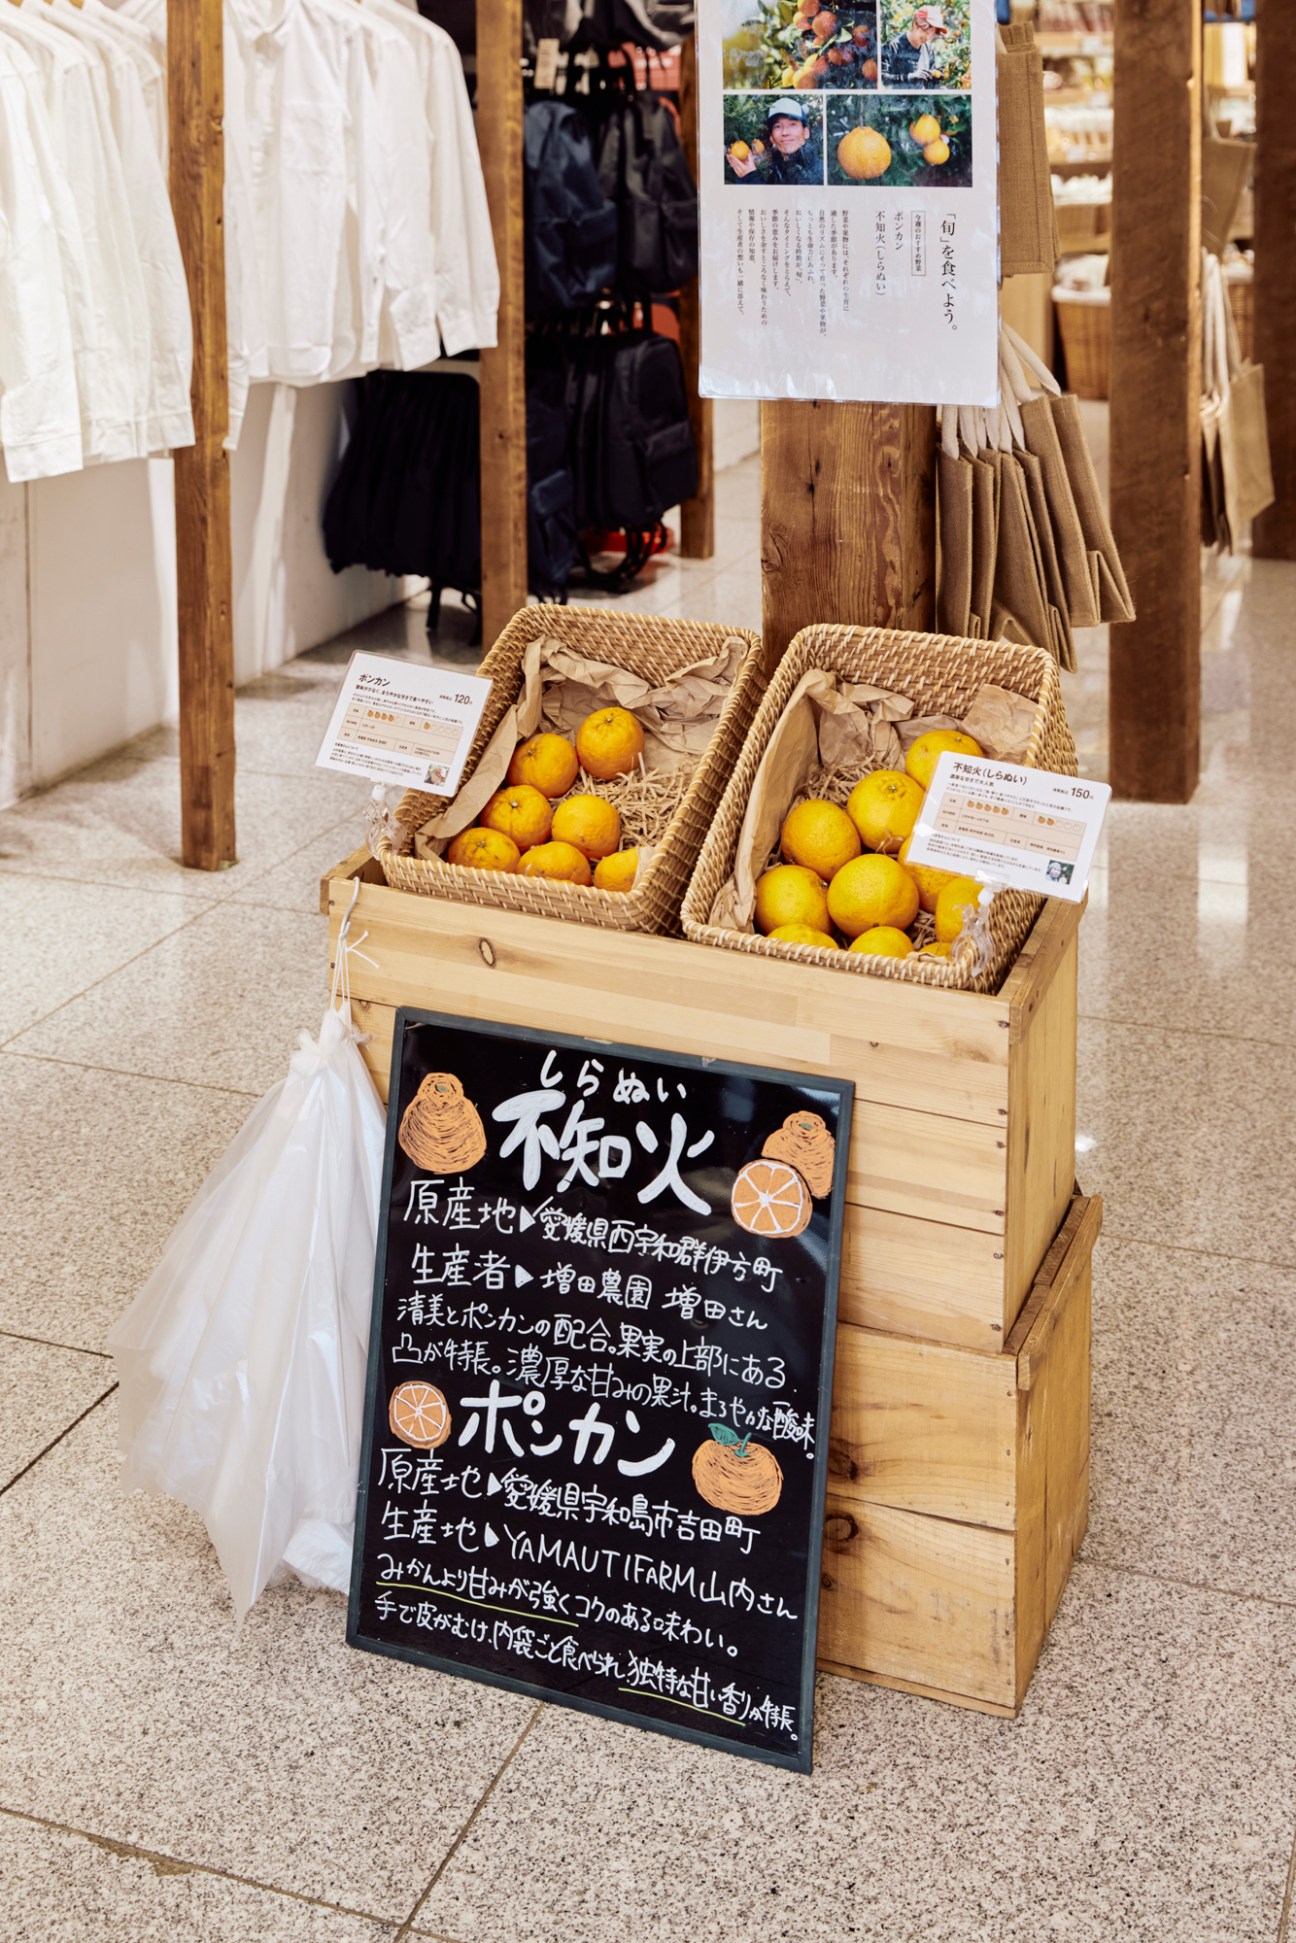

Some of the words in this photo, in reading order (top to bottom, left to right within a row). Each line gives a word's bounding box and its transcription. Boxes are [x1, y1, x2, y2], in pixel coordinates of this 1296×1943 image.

[939, 212, 958, 331] 「旬」を食べよう。
[358, 673, 391, 687] ポンカン
[540, 1050, 687, 1103] しらぬい
[492, 1089, 714, 1216] 不知火
[403, 1176, 516, 1235] 原産地
[411, 1242, 511, 1290] 生産者
[539, 1261, 653, 1310] 増田農園
[661, 1282, 768, 1331] 増田さん
[458, 1379, 676, 1477] ポンカン
[377, 1448, 482, 1498] 原産地
[381, 1501, 480, 1553] 生産地
